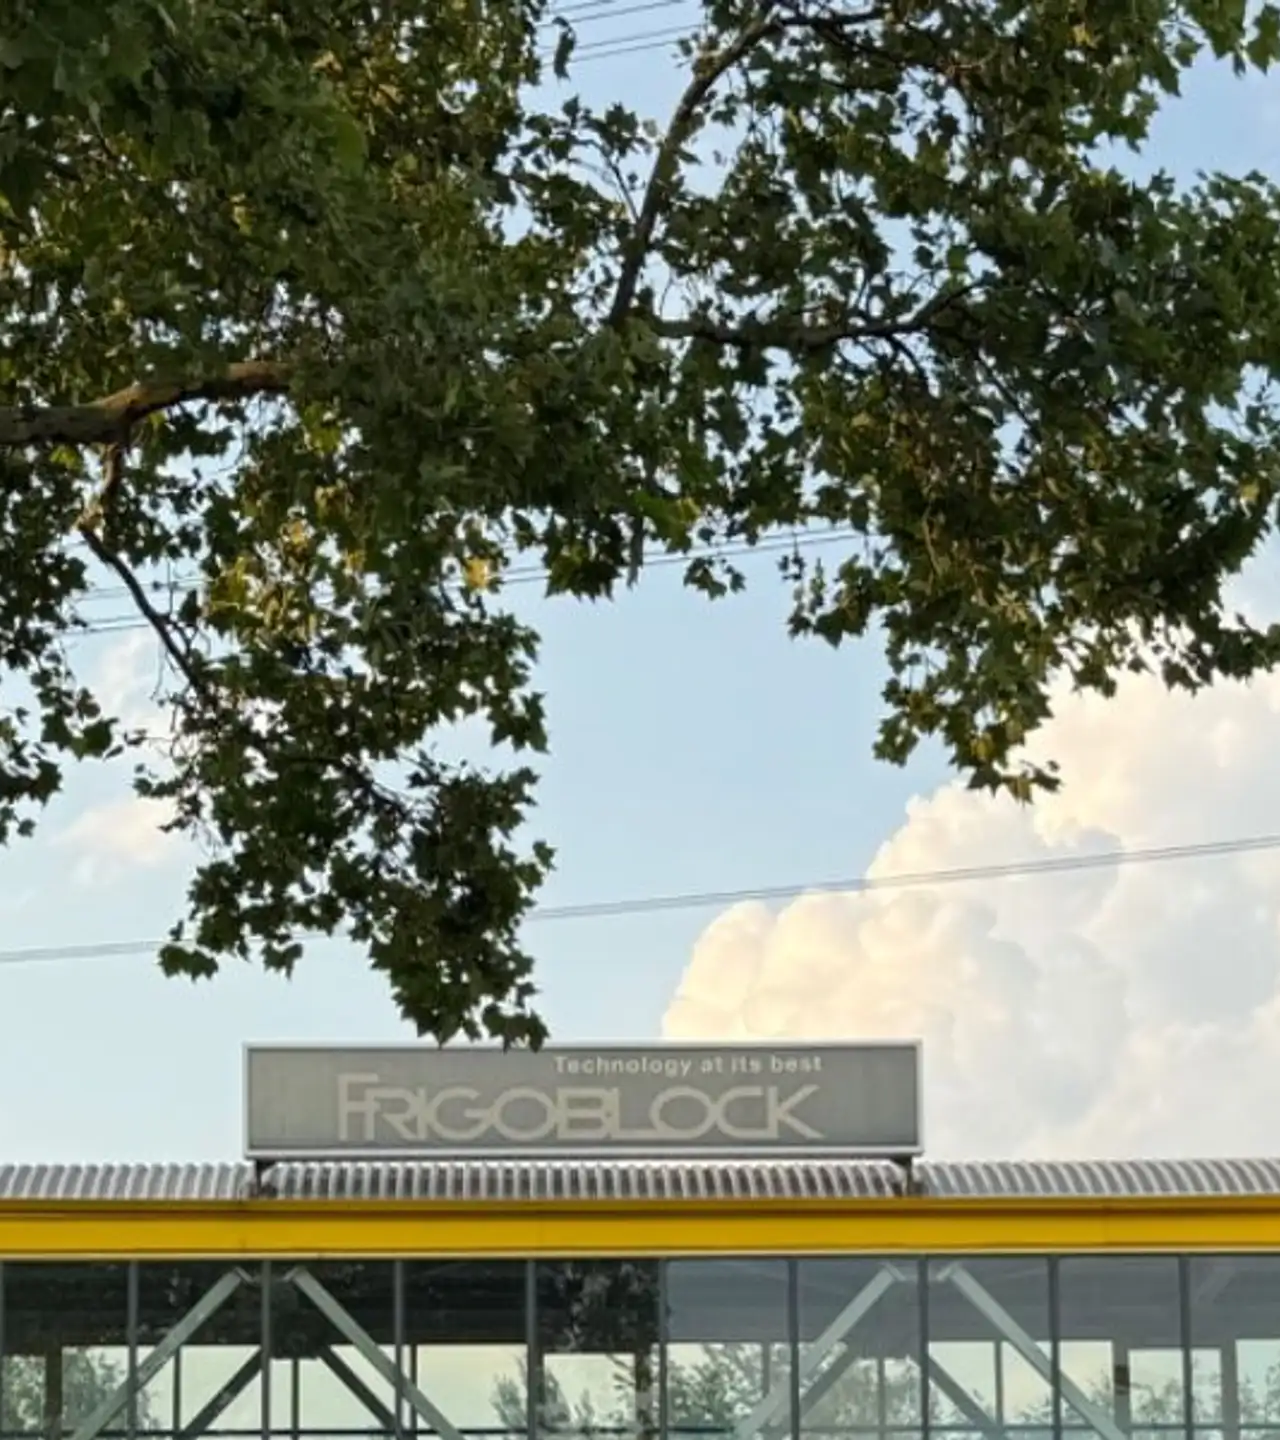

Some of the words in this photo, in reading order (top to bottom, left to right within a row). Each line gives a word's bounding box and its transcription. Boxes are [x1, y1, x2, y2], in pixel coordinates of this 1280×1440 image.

[553, 1055, 693, 1078] Technology
[699, 1056, 724, 1074] at
[731, 1055, 762, 1074] its
[770, 1054, 822, 1074] best
[337, 1072, 824, 1141] FRIGOBLOCK
